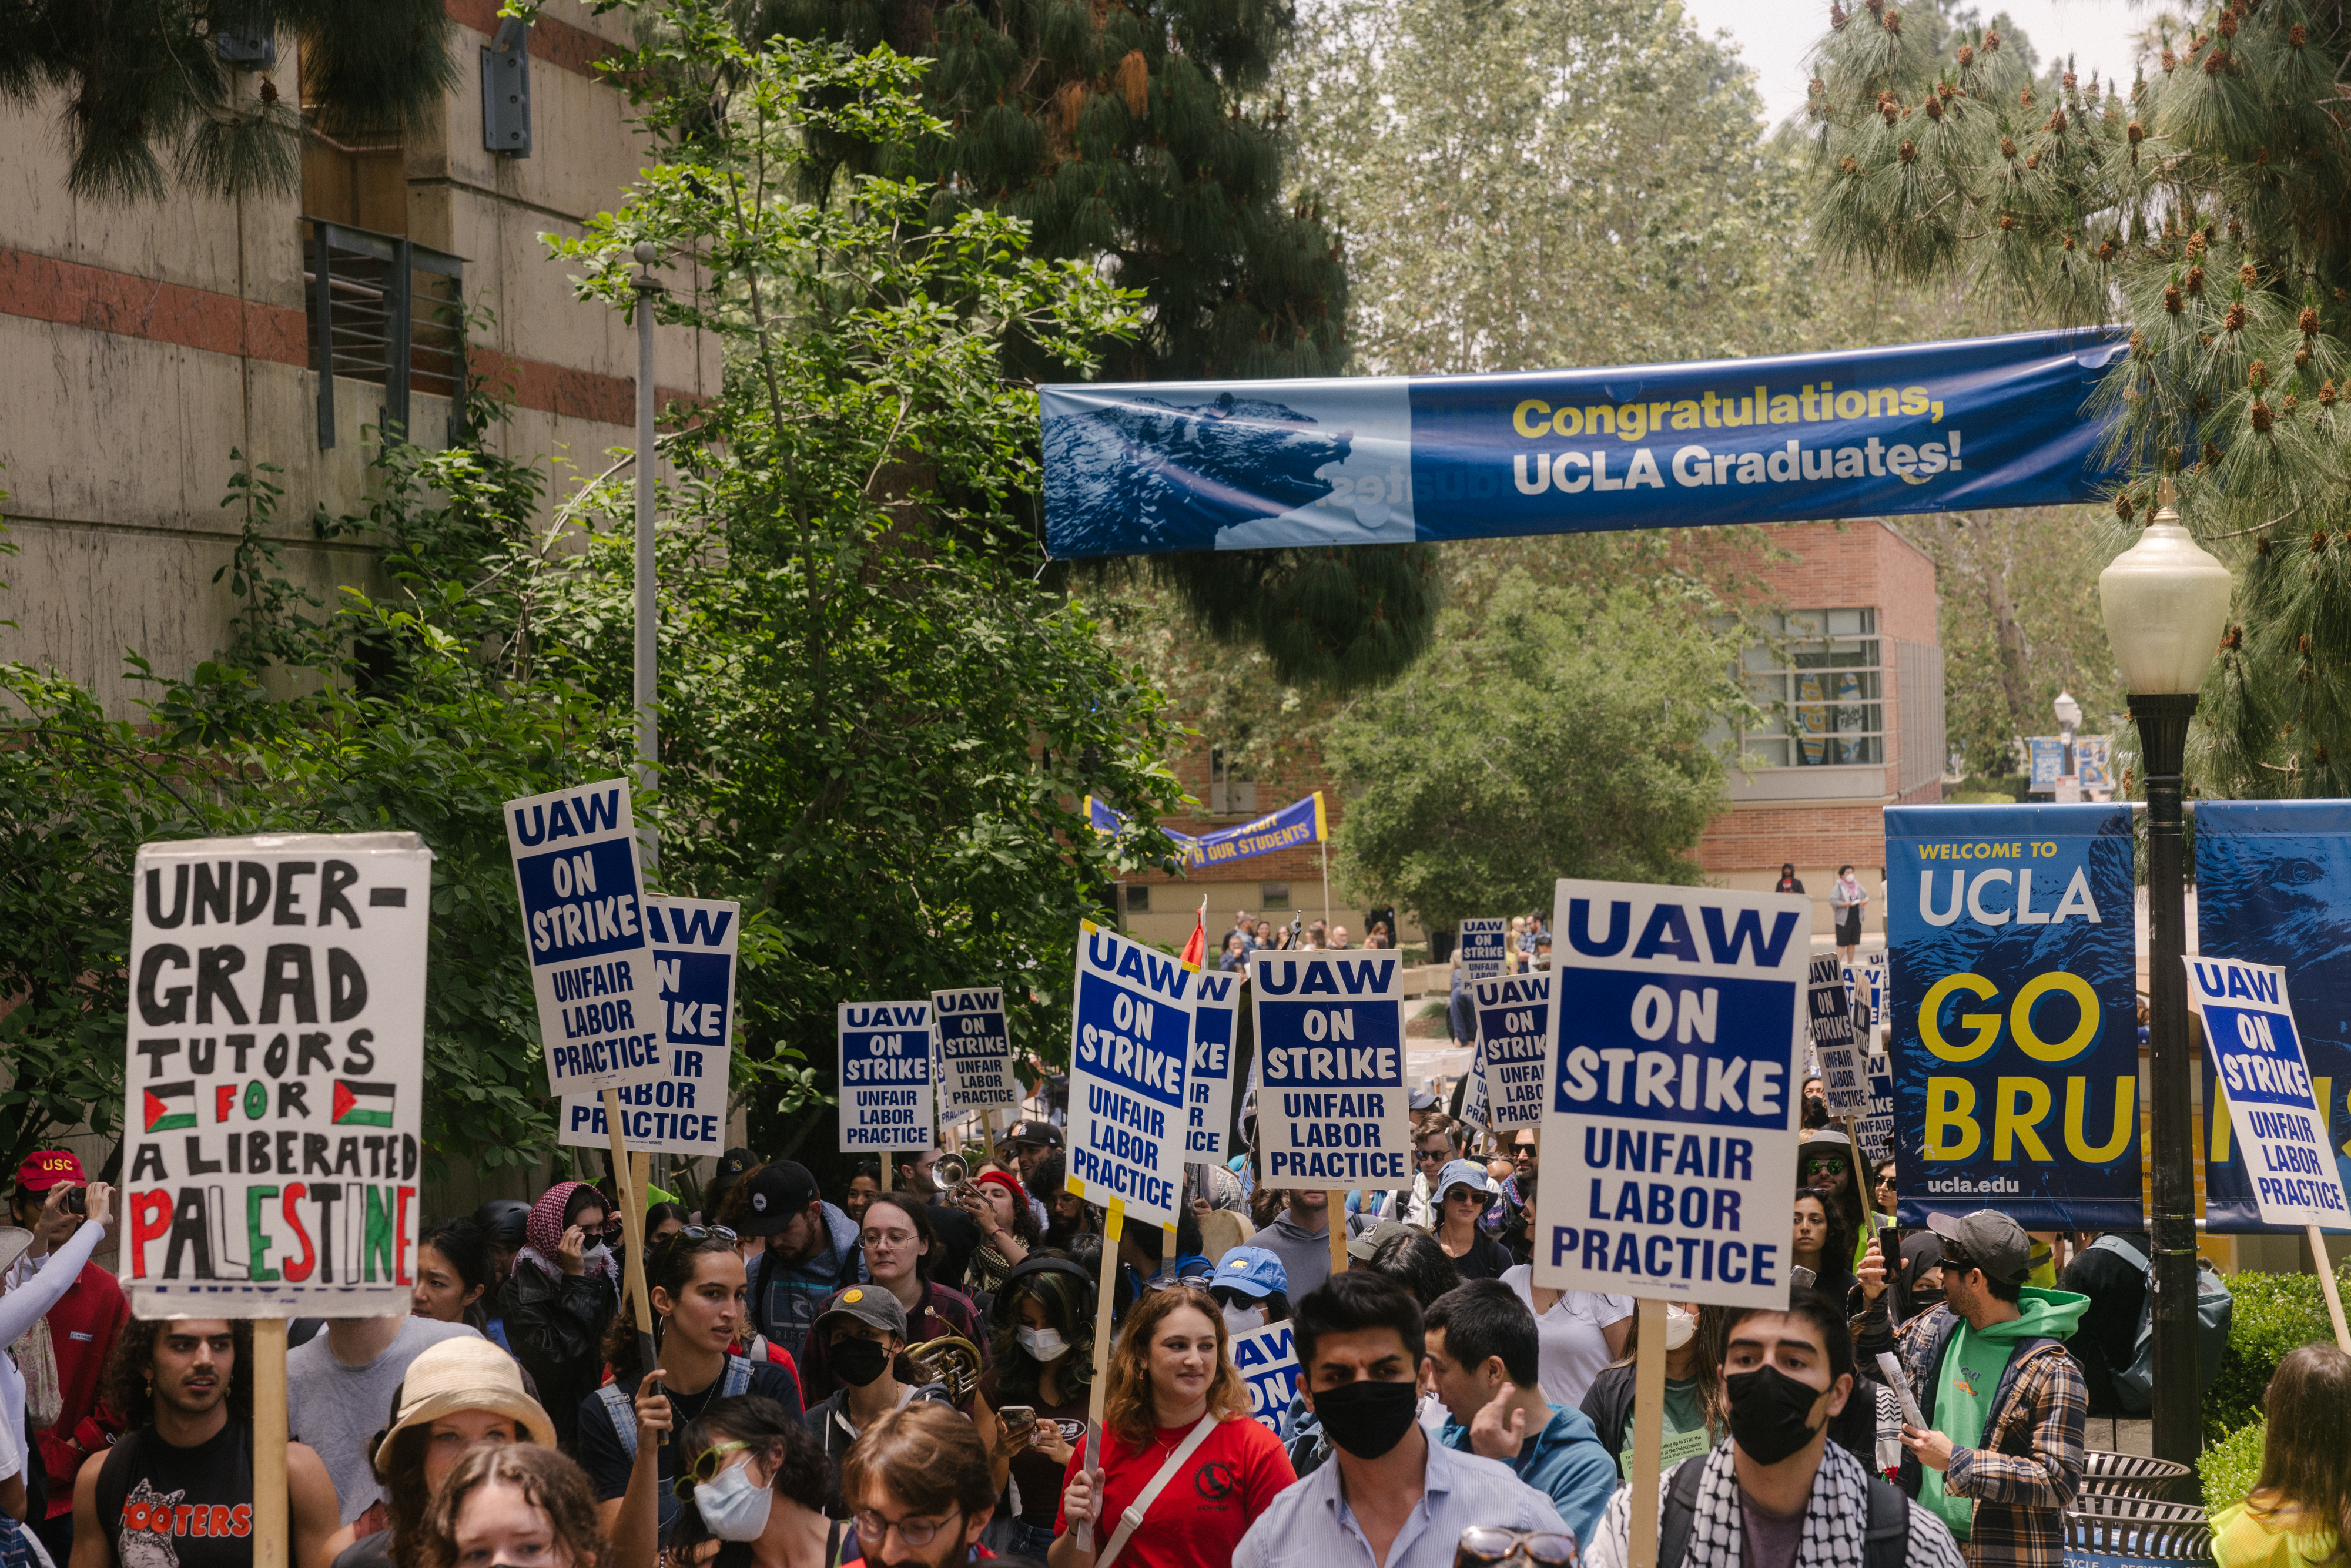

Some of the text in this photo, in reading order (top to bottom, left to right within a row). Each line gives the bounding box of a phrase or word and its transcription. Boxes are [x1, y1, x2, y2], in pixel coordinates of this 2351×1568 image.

[1513, 381, 1944, 441] Congratulations,
[1513, 431, 1962, 495] UCLA Graduates!
[514, 789, 619, 847] UAW
[1208, 842, 1238, 861] OUR
[1240, 823, 1310, 855] STUDENTS
[1918, 841, 2057, 860] WELCOME TO
[552, 850, 597, 898] ON
[146, 860, 406, 930] UNDER-
[1919, 865, 2101, 927] UCLA
[534, 894, 638, 952] STRIKE
[1464, 922, 1503, 932] UAW
[1475, 934, 1492, 946] ON
[1569, 898, 1800, 968] UAW
[1089, 932, 1190, 1000] UAW
[1463, 946, 1503, 959] STRIKE
[1469, 963, 1499, 971] UNFAIR
[137, 943, 367, 1026] GRAD
[552, 961, 634, 1003] UNFAIR
[1259, 960, 1396, 996] UAW
[1476, 977, 1550, 1006] UAW
[2193, 962, 2279, 1004] UAW
[562, 999, 635, 1039] LABOR
[847, 1007, 927, 1027] UAW
[936, 992, 999, 1013] UAW
[1113, 992, 1153, 1041] ON
[1631, 984, 1719, 1044] ON
[1818, 990, 1834, 1014] ON
[1918, 971, 2100, 1062] GO
[961, 1017, 985, 1034] ON
[1303, 1008, 1354, 1042] ON
[1505, 1010, 1535, 1033] ON
[1814, 1015, 1852, 1041] STRIKE
[2237, 1012, 2276, 1053] ON
[137, 1028, 374, 1078] TUTORS
[553, 1033, 660, 1078] PRACTICE
[870, 1034, 902, 1056] ON
[946, 1036, 1006, 1056] STRIKE
[1080, 1023, 1183, 1094] STRIKE
[1488, 1033, 1547, 1060] STRIK
[1823, 1050, 1853, 1068] UNFAIR
[846, 1058, 926, 1080] STRIKE
[956, 1060, 1003, 1074] UNFAIR
[1267, 1046, 1397, 1080] STRIKE
[1828, 1070, 1856, 1088] LABOR
[2224, 1053, 2309, 1098] STRIKE
[953, 1090, 1014, 1104] PRACTICE
[961, 1075, 1002, 1089] LABOR
[1505, 1084, 1543, 1103] LABO
[1562, 1045, 1784, 1116] STRIKE
[215, 1080, 310, 1123] FOR
[856, 1090, 917, 1107] UNFAIR
[1089, 1084, 1165, 1139] UNFAIR
[1284, 1093, 1385, 1118] UNFAIR
[1828, 1090, 1866, 1108] PRACTICE
[860, 1109, 914, 1125] LABOR
[1923, 1076, 2135, 1164] BRU
[2248, 1110, 2316, 1144] UNFAIR
[847, 1127, 927, 1144] PRACTICE
[1090, 1119, 1158, 1171] LABOR
[1290, 1123, 1381, 1148] LABOR
[43, 1158, 73, 1171] USC
[130, 1131, 417, 1182] A LIBERATED
[1271, 1152, 1405, 1178] PRACTICE
[1585, 1126, 1754, 1181] UNFAIR
[2262, 1144, 2323, 1176] LABOR
[1074, 1146, 1174, 1211] PRACTICE
[1928, 1177, 2019, 1194] ucla.edu
[2258, 1177, 2345, 1211] PRACTICE
[1590, 1178, 1742, 1232] LABOR
[130, 1182, 415, 1286] PALESTINE
[1551, 1225, 1777, 1287] PRACTICE
[1234, 1328, 1299, 1370] AW
[1243, 1372, 1290, 1413] ON
[1676, 1442, 1702, 1453] Palestinians!
[2063, 1557, 2099, 1568] CYCLE
